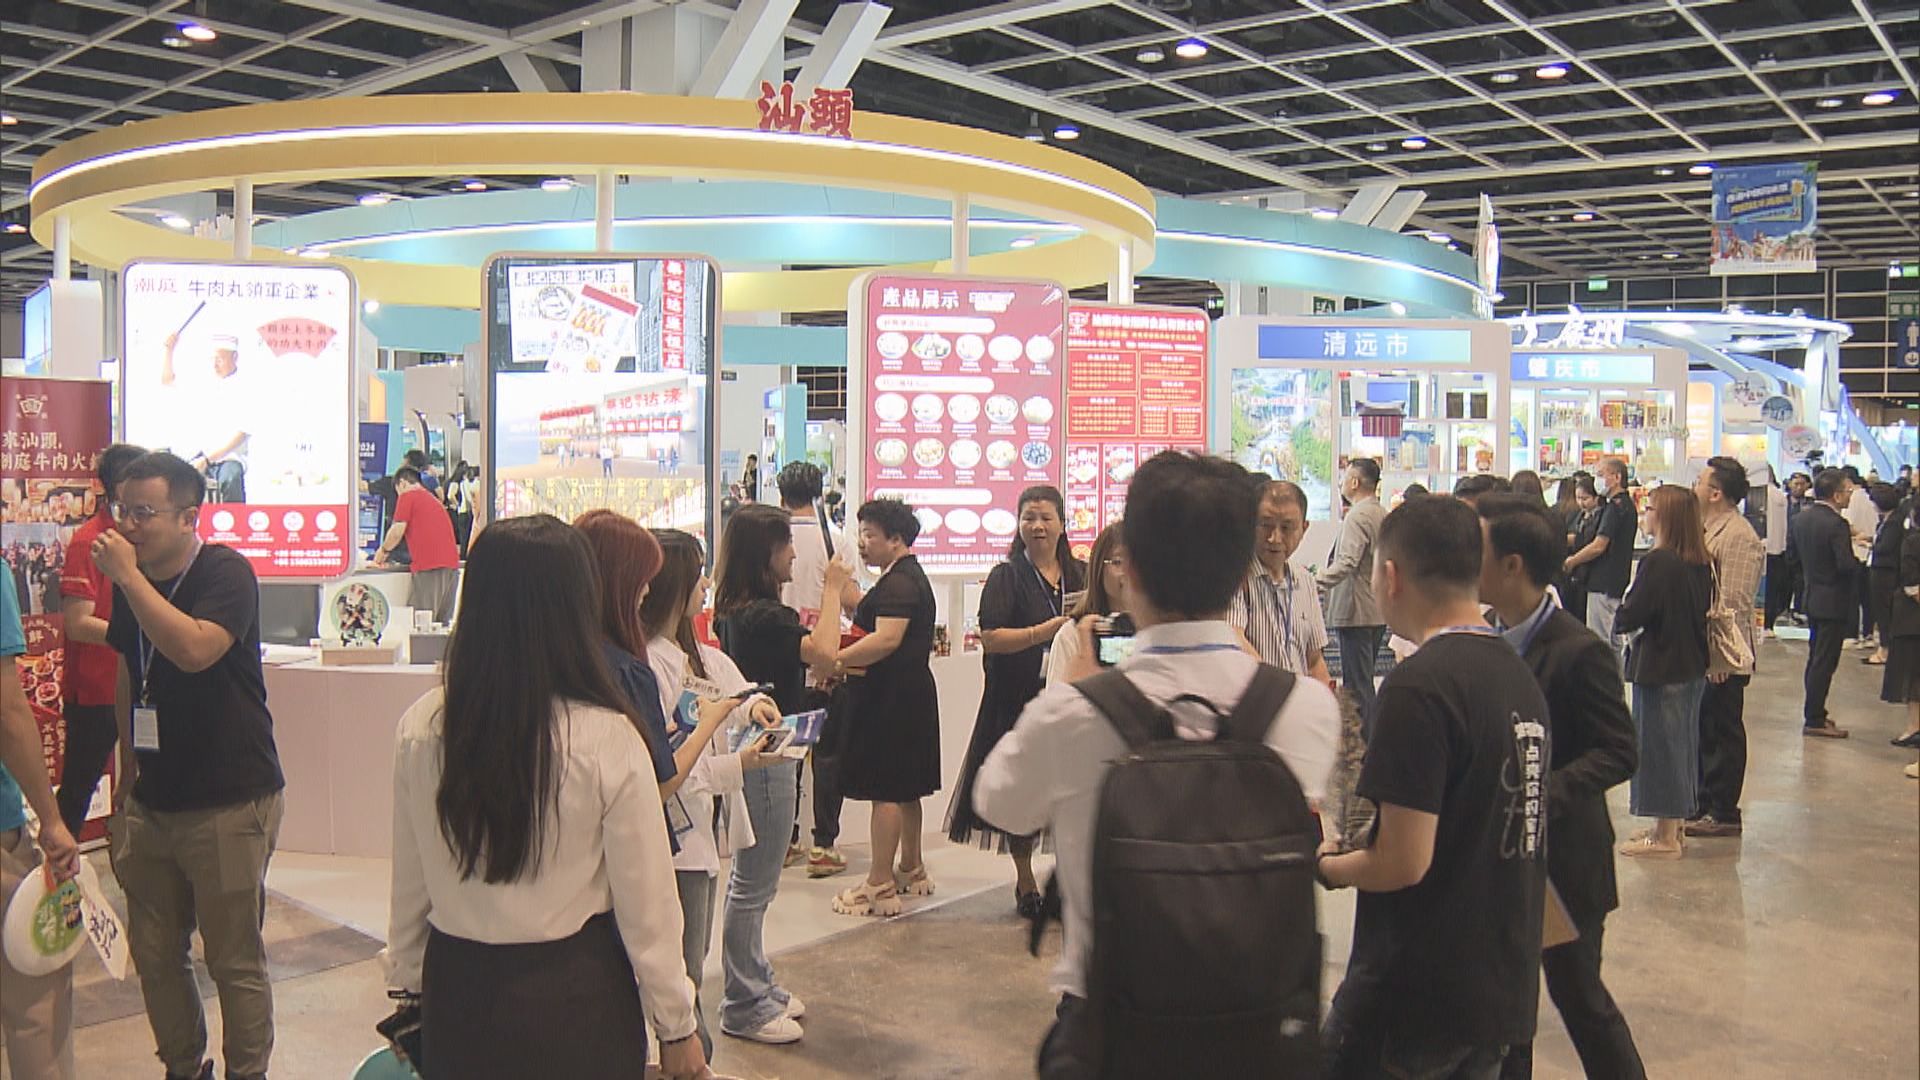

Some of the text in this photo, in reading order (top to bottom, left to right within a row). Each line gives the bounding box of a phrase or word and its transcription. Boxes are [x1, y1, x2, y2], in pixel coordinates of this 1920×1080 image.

[758, 80, 853, 140] 汕頭
[189, 279, 319, 300] 牛肉丸領軍企業
[1323, 330, 1409, 357] 清远市
[1528, 357, 1601, 378] 肇庆市
